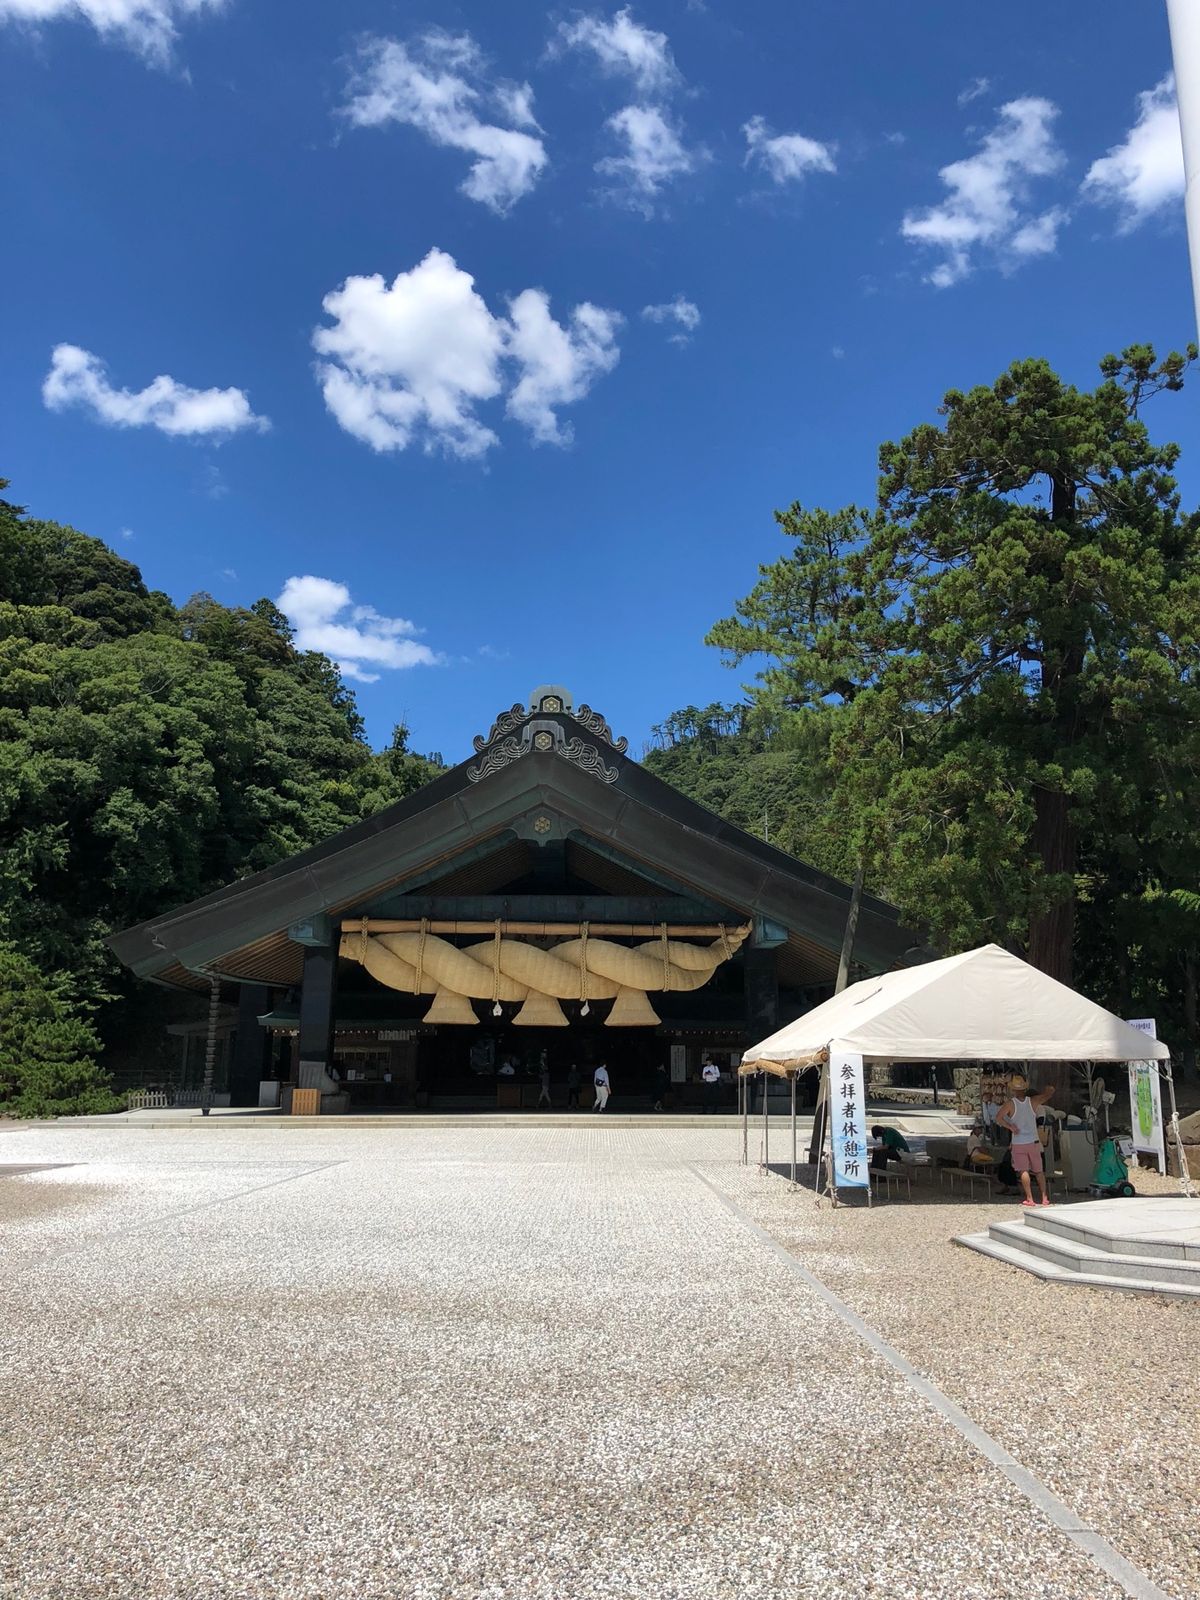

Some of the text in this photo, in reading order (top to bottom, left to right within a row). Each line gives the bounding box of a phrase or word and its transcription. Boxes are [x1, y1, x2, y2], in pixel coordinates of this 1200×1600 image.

[840, 1063, 860, 1177] 参拝者休憩所
